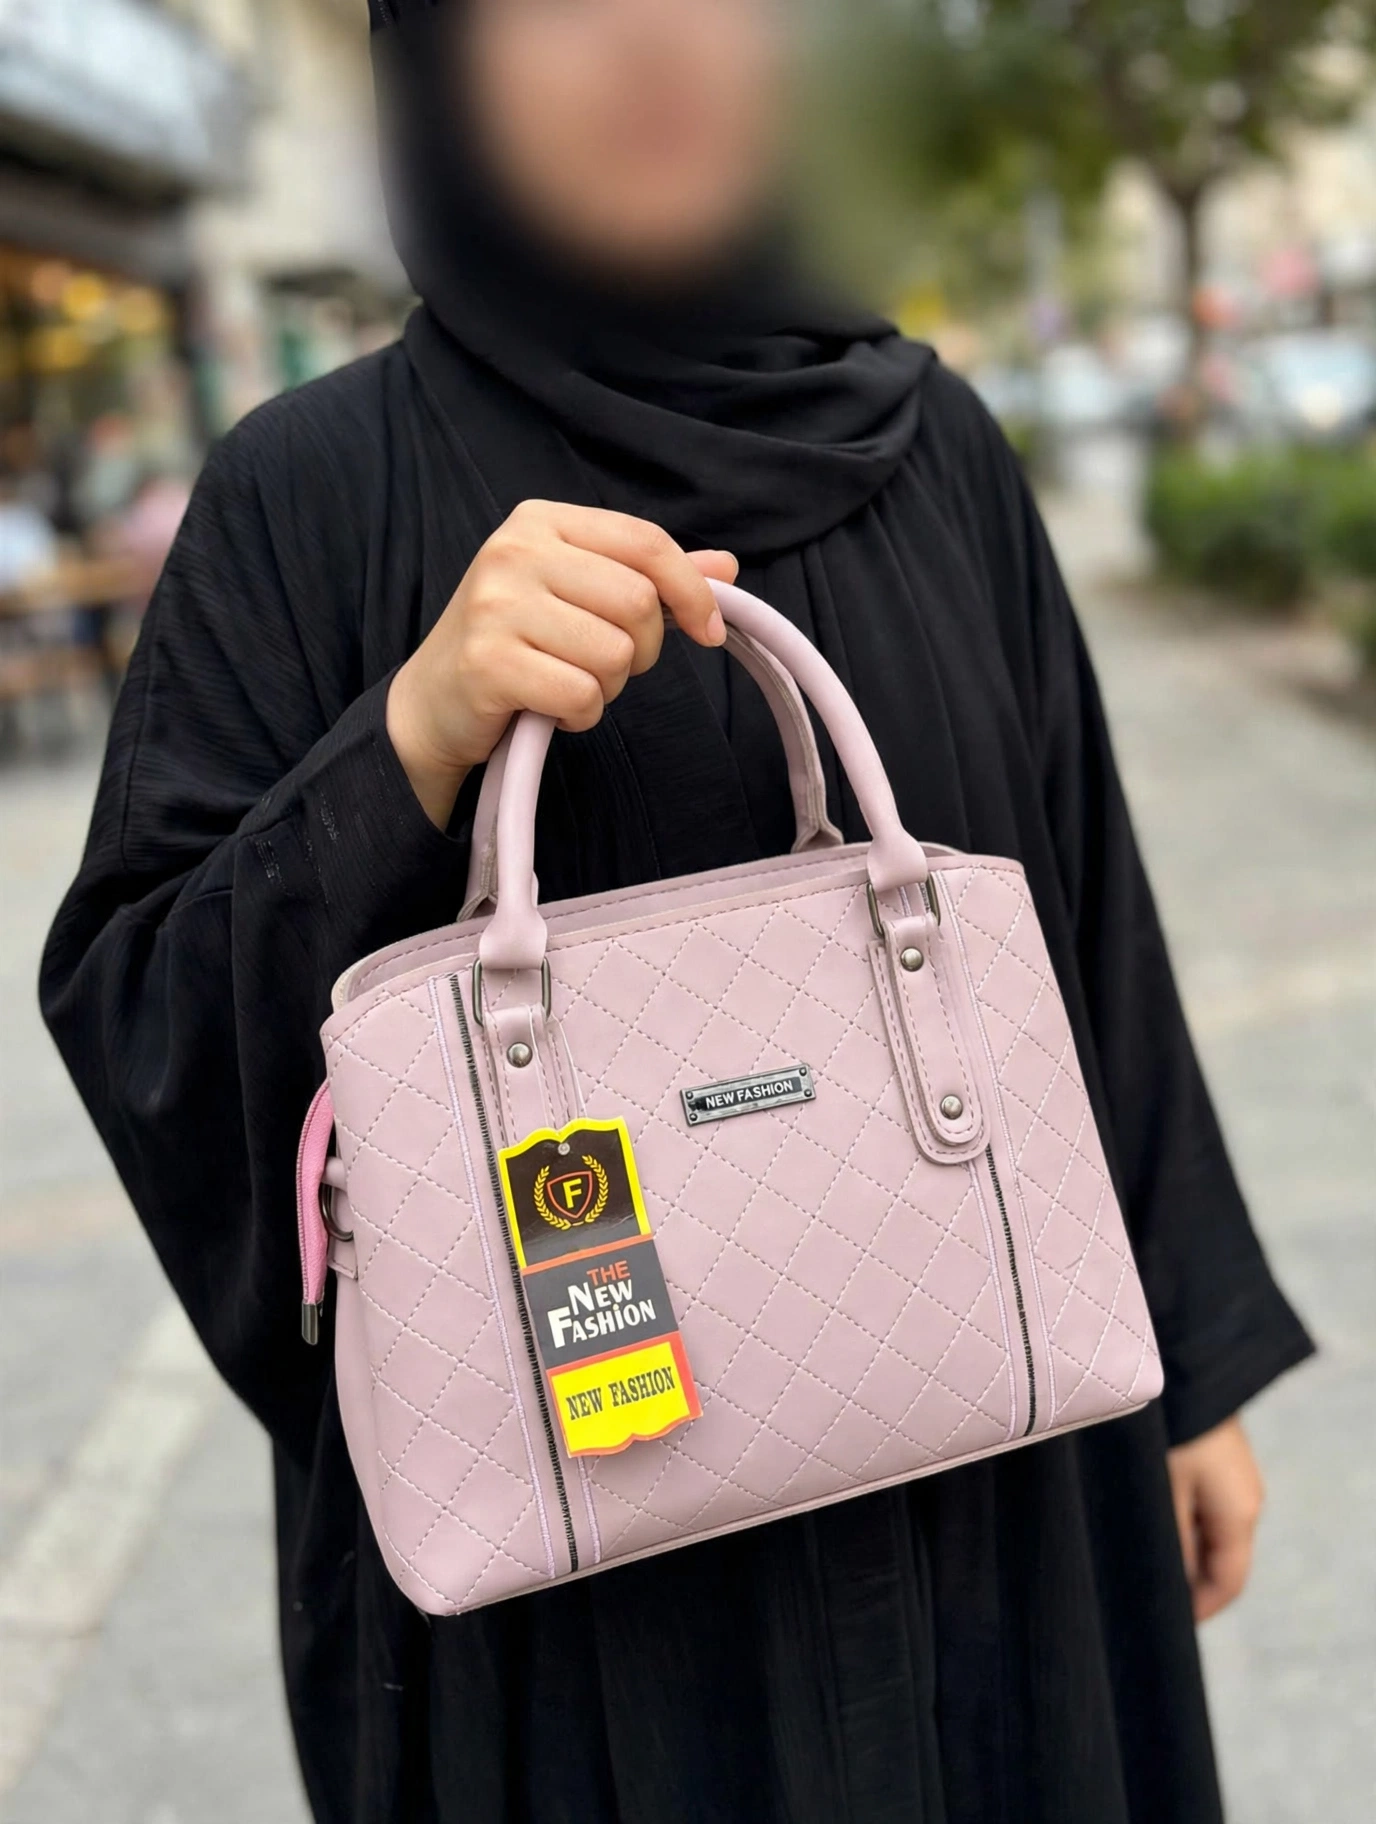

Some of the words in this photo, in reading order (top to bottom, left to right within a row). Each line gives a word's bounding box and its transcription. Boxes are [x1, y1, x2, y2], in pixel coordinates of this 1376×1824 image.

[706, 1091, 735, 1109] NEW
[736, 1079, 793, 1102] FASHION
[562, 1178, 582, 1209] F
[586, 1260, 630, 1286] THE
[567, 1279, 633, 1316] NEW
[565, 1387, 603, 1421] NEW
[608, 1366, 675, 1407] FASHION
